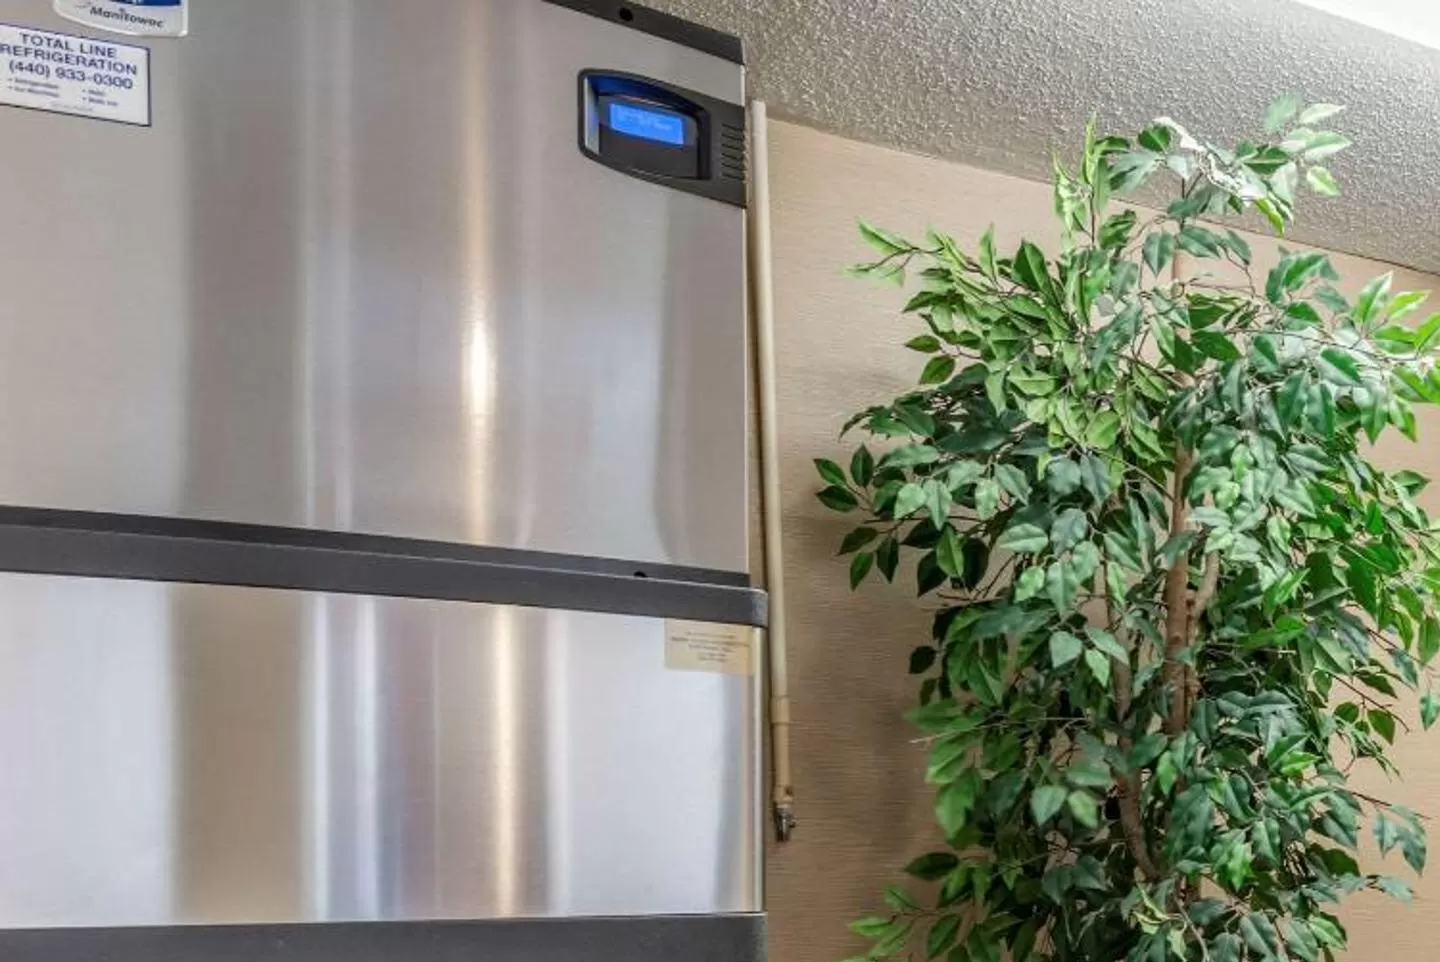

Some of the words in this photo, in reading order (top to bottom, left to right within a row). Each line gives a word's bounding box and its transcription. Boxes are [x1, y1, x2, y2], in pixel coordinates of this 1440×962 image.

[89, 6, 165, 28] Manitowoc
[19, 32, 74, 52] TOTAL
[80, 43, 117, 58] LINE
[0, 43, 138, 75] REFRIGERATION
[9, 61, 50, 79] (440)
[55, 68, 134, 89] 933-0300
